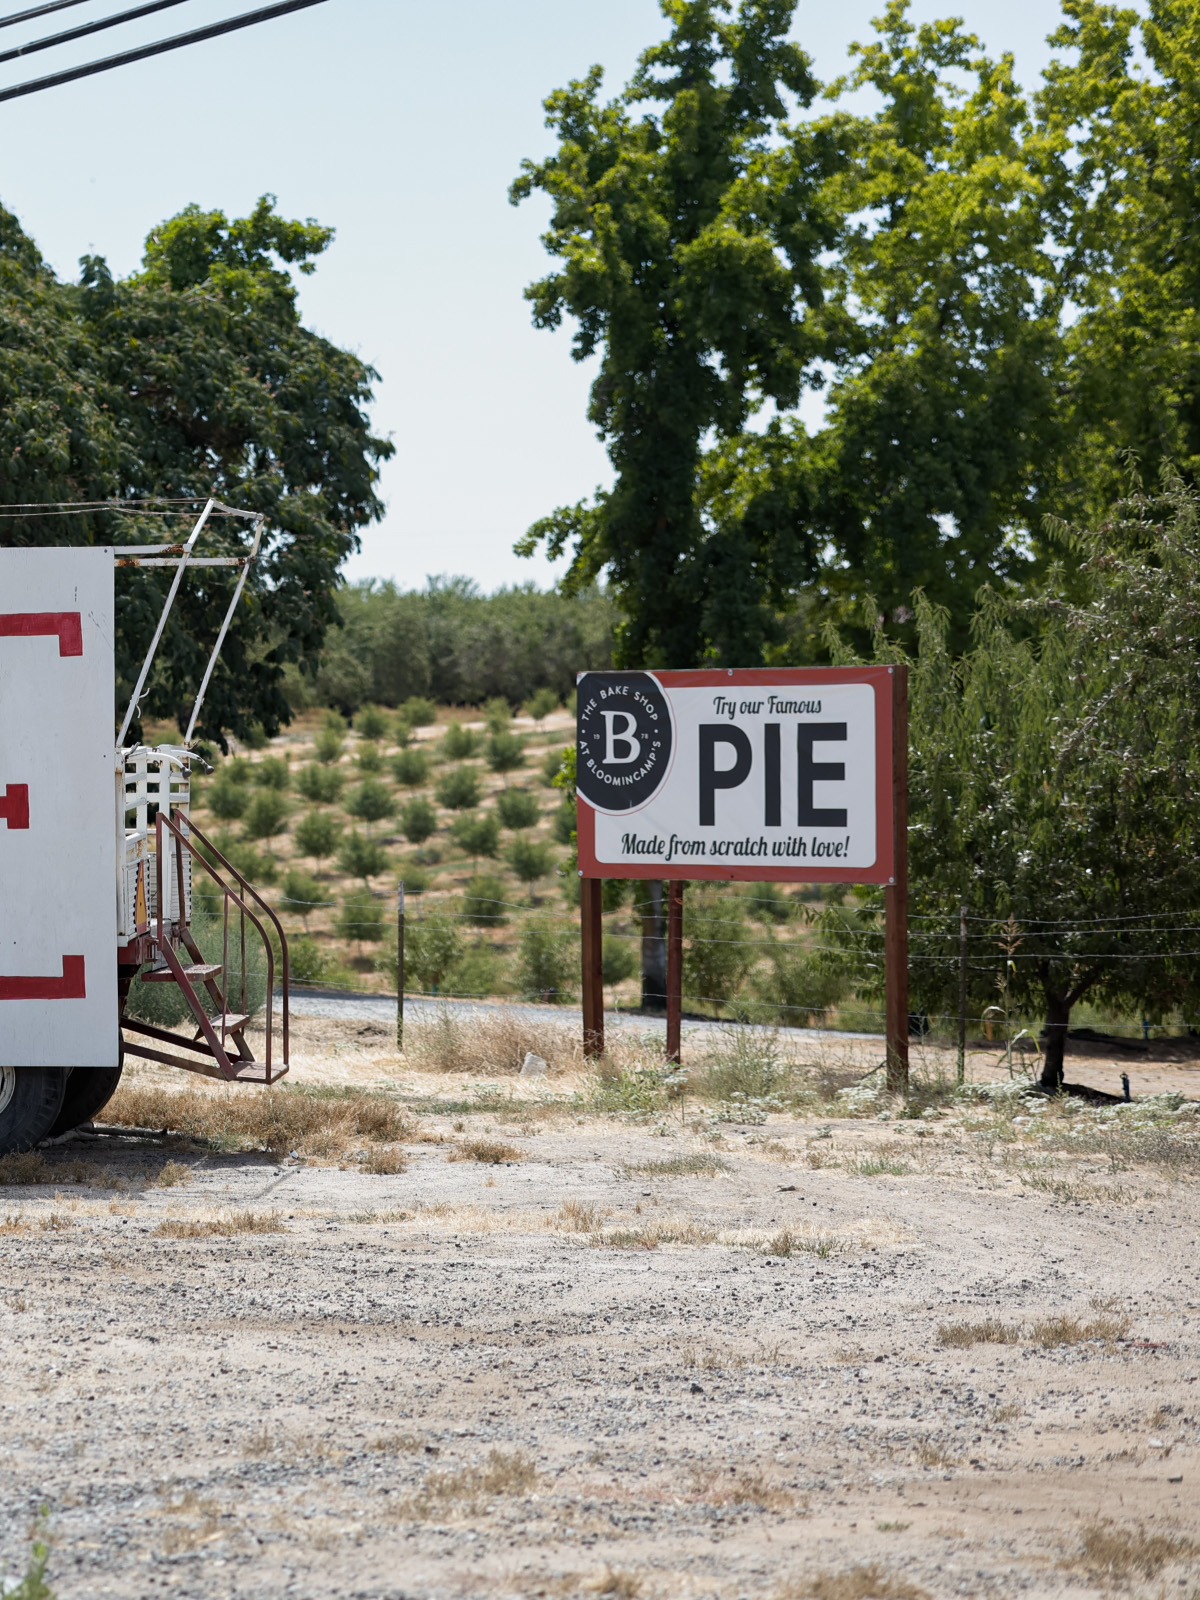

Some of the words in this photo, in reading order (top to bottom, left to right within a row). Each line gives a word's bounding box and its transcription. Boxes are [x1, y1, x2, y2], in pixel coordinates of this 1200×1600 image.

[581, 698, 598, 721] THE
[599, 685, 630, 700] BAKE
[633, 691, 658, 721] SHOP
[713, 696, 737, 720] Try
[739, 700, 765, 715] our
[767, 695, 822, 715] Famous
[599, 710, 641, 765] B
[579, 740, 590, 756] AT
[586, 740, 662, 787] BLOOMINCAMP'S
[698, 722, 848, 828] PIE
[621, 833, 666, 855] Made
[665, 833, 706, 861] from
[709, 836, 768, 857] scratch
[772, 836, 807, 857] with
[811, 835, 851, 858] love!
